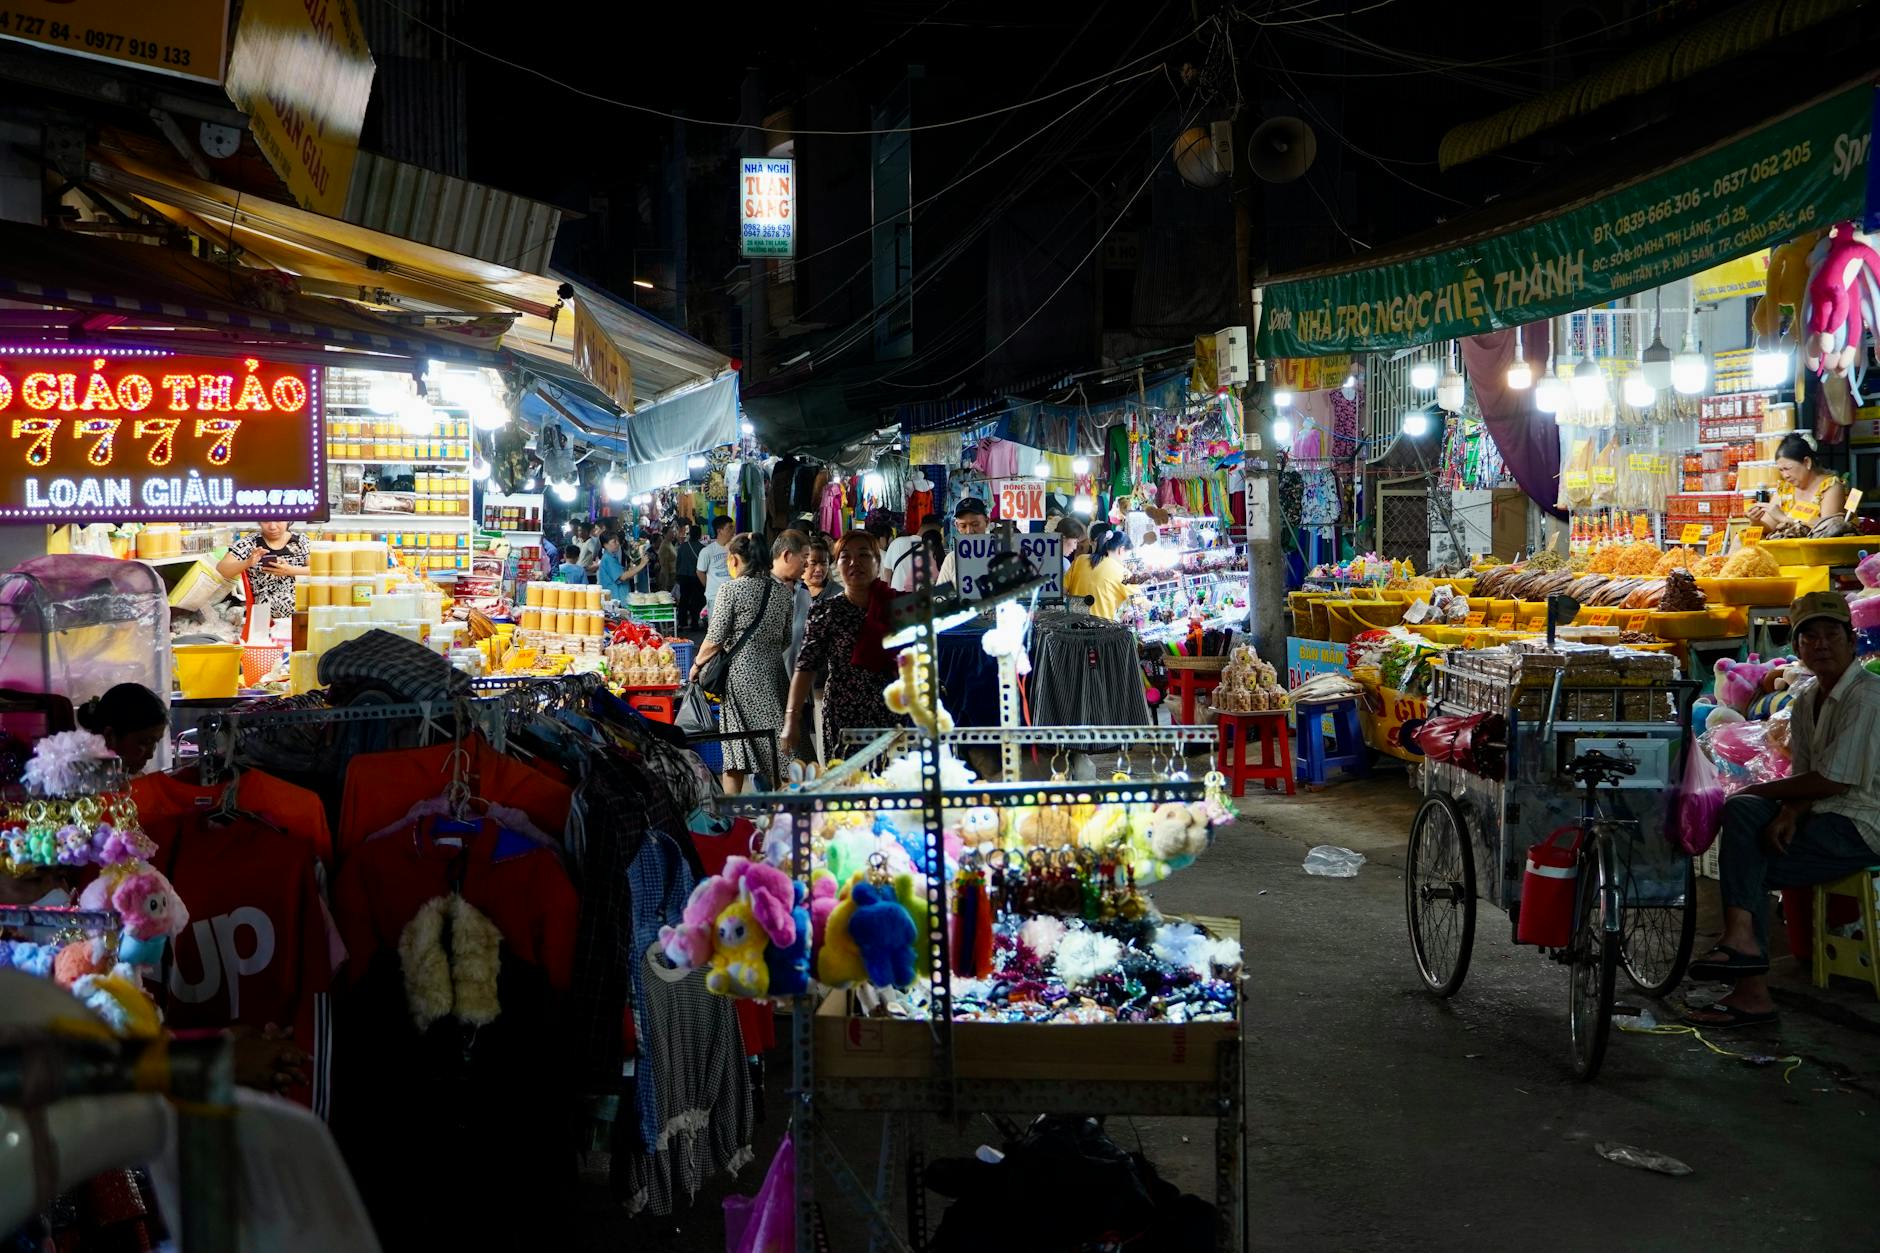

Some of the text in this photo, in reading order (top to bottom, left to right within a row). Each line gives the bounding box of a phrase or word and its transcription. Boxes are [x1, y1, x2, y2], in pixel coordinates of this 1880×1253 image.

[15, 14, 45, 35] 727
[50, 22, 69, 41] 84
[86, 30, 124, 52] 0977
[129, 39, 157, 59] 919
[164, 46, 190, 66] 133
[1615, 210, 1645, 237] 0839
[1648, 200, 1672, 224] 666
[1674, 188, 1701, 214] 306
[1712, 168, 1748, 199] 0637
[1750, 156, 1780, 183] 062
[1782, 140, 1812, 172] 205
[1798, 204, 1816, 225] AG
[1644, 238, 1664, 257] KHA
[1268, 306, 1292, 336] Sprite
[1297, 298, 1332, 344] NHÀ
[1336, 302, 1370, 346] TRỌ
[1374, 290, 1433, 341] NGỌC
[1493, 248, 1584, 312] THÀNH
[22, 358, 153, 411] GIÁO
[161, 358, 307, 412] THẢO
[25, 478, 131, 507] LOAN
[143, 470, 233, 507] GIÀU
[1002, 490, 1043, 519] 39K
[1021, 538, 1059, 562] SỌT
